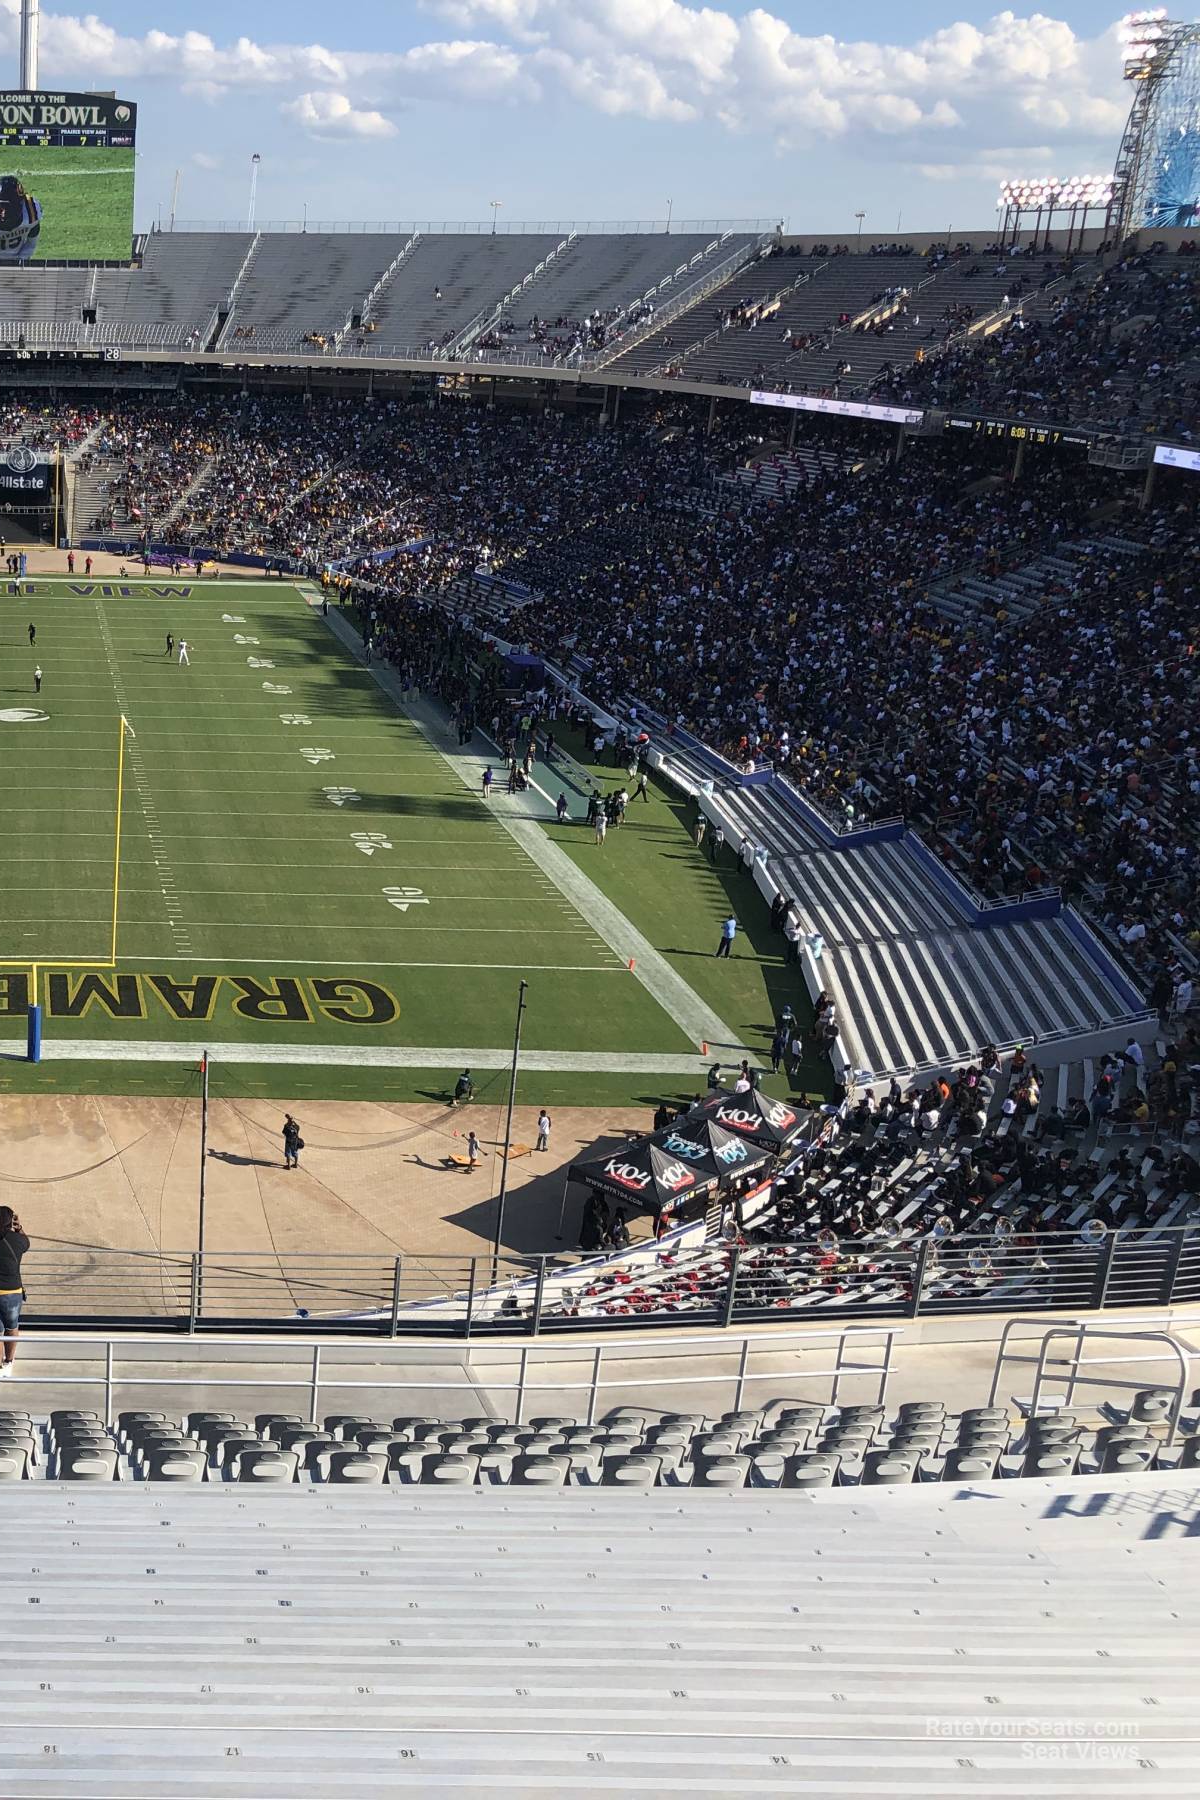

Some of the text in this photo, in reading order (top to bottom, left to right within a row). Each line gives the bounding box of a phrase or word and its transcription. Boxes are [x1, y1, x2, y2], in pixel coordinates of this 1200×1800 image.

[34, 95, 46, 103] TO
[48, 95, 65, 103] THE
[40, 105, 106, 126] BOWL
[80, 136, 87, 145] 7
[107, 348, 119, 358] 28
[66, 584, 194, 598] VIEW
[279, 714, 312, 725] 50
[321, 786, 362, 801] 30
[350, 832, 393, 849] 20
[381, 887, 430, 904] 10
[716, 1106, 763, 1128] K104
[604, 1160, 652, 1187] K104
[656, 1162, 692, 1189] K104
[39, 1682, 52, 1691] 18
[200, 1684, 212, 1693] 17
[357, 1686, 371, 1694] 16
[515, 1688, 528, 1696] 15
[672, 1690, 687, 1698] 14
[831, 1693, 845, 1701] 13
[983, 1695, 1000, 1704] 12
[43, 1744, 57, 1754] 18
[226, 1747, 240, 1756] 17
[400, 1749, 416, 1758] 16
[586, 1752, 601, 1761] 15
[772, 1755, 789, 1765] 14
[957, 1758, 974, 1768] 13
[1137, 1759, 1153, 1769] 12
